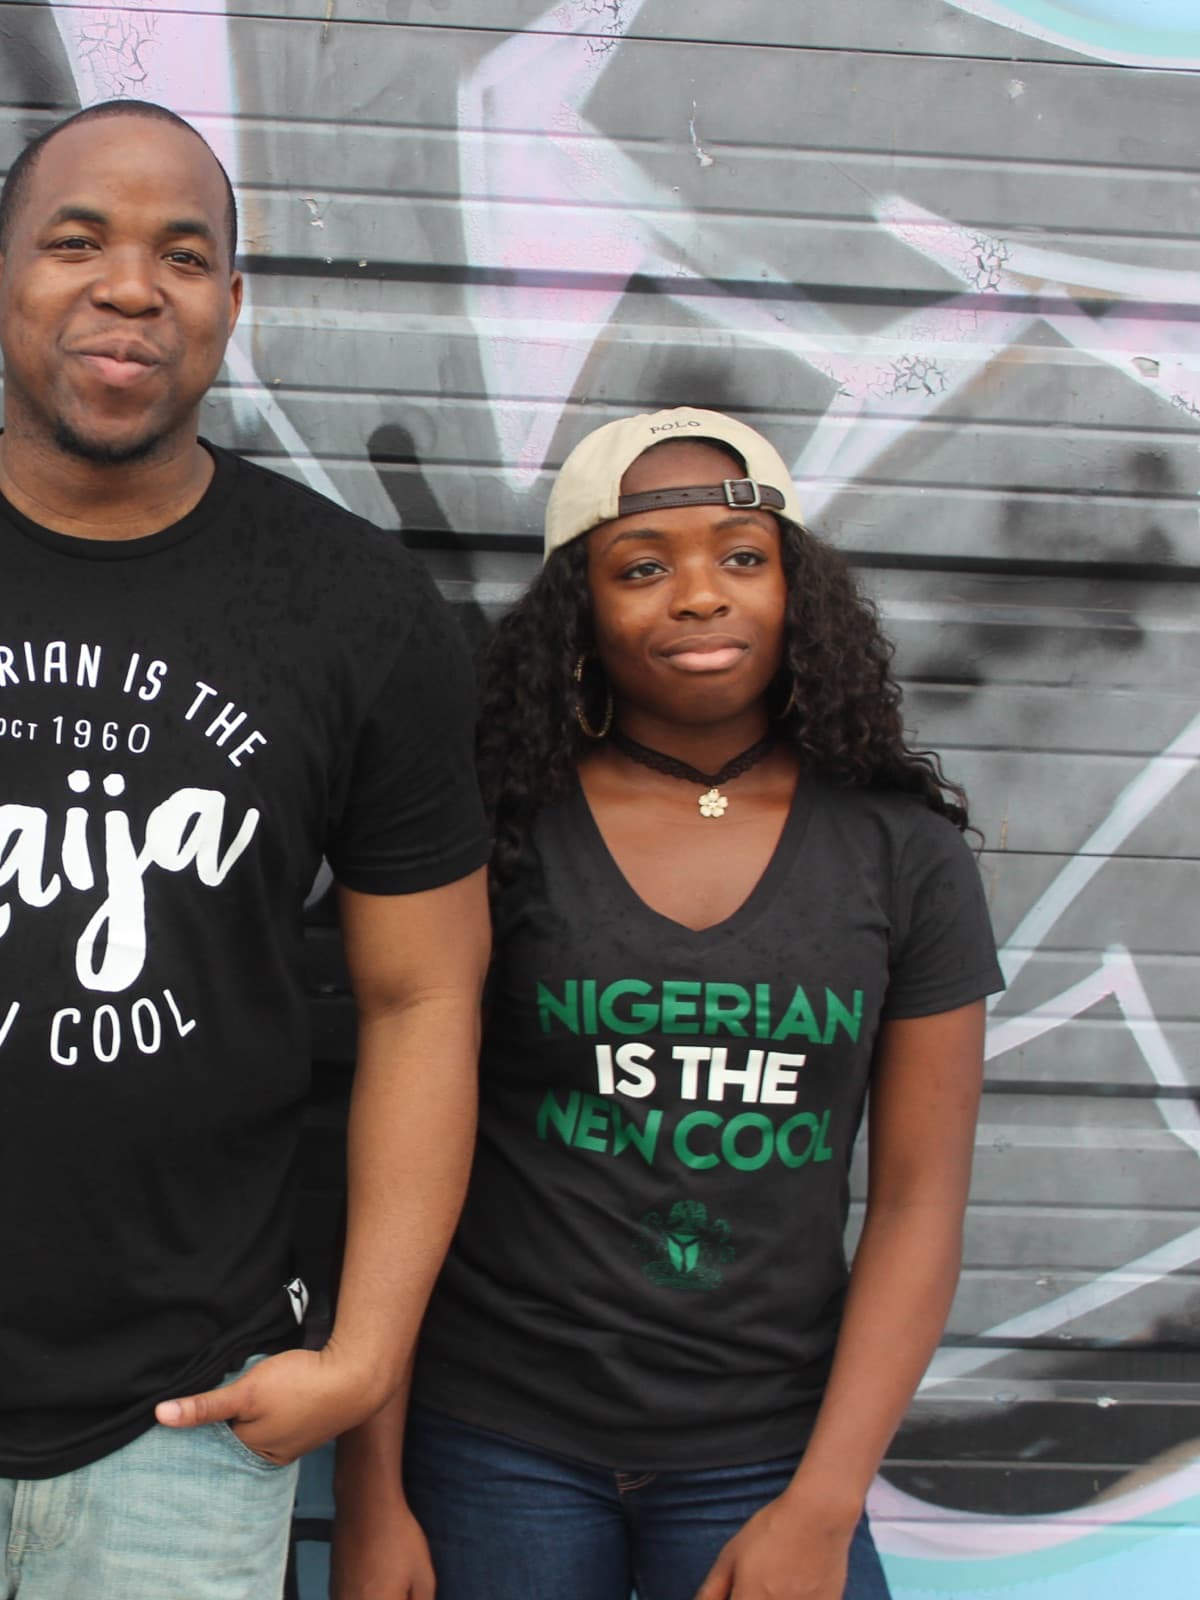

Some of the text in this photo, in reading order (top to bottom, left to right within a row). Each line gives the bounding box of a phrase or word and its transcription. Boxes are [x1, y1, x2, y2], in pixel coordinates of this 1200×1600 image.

[649, 419, 702, 435] POLO
[52, 715, 152, 754] 1960
[123, 652, 168, 701] IS
[184, 680, 268, 768] THE
[49, 988, 197, 1066] COOL
[536, 978, 864, 1045] NIGERIAN
[594, 1042, 807, 1105] IS THE
[535, 1087, 833, 1172] NEW COOL
